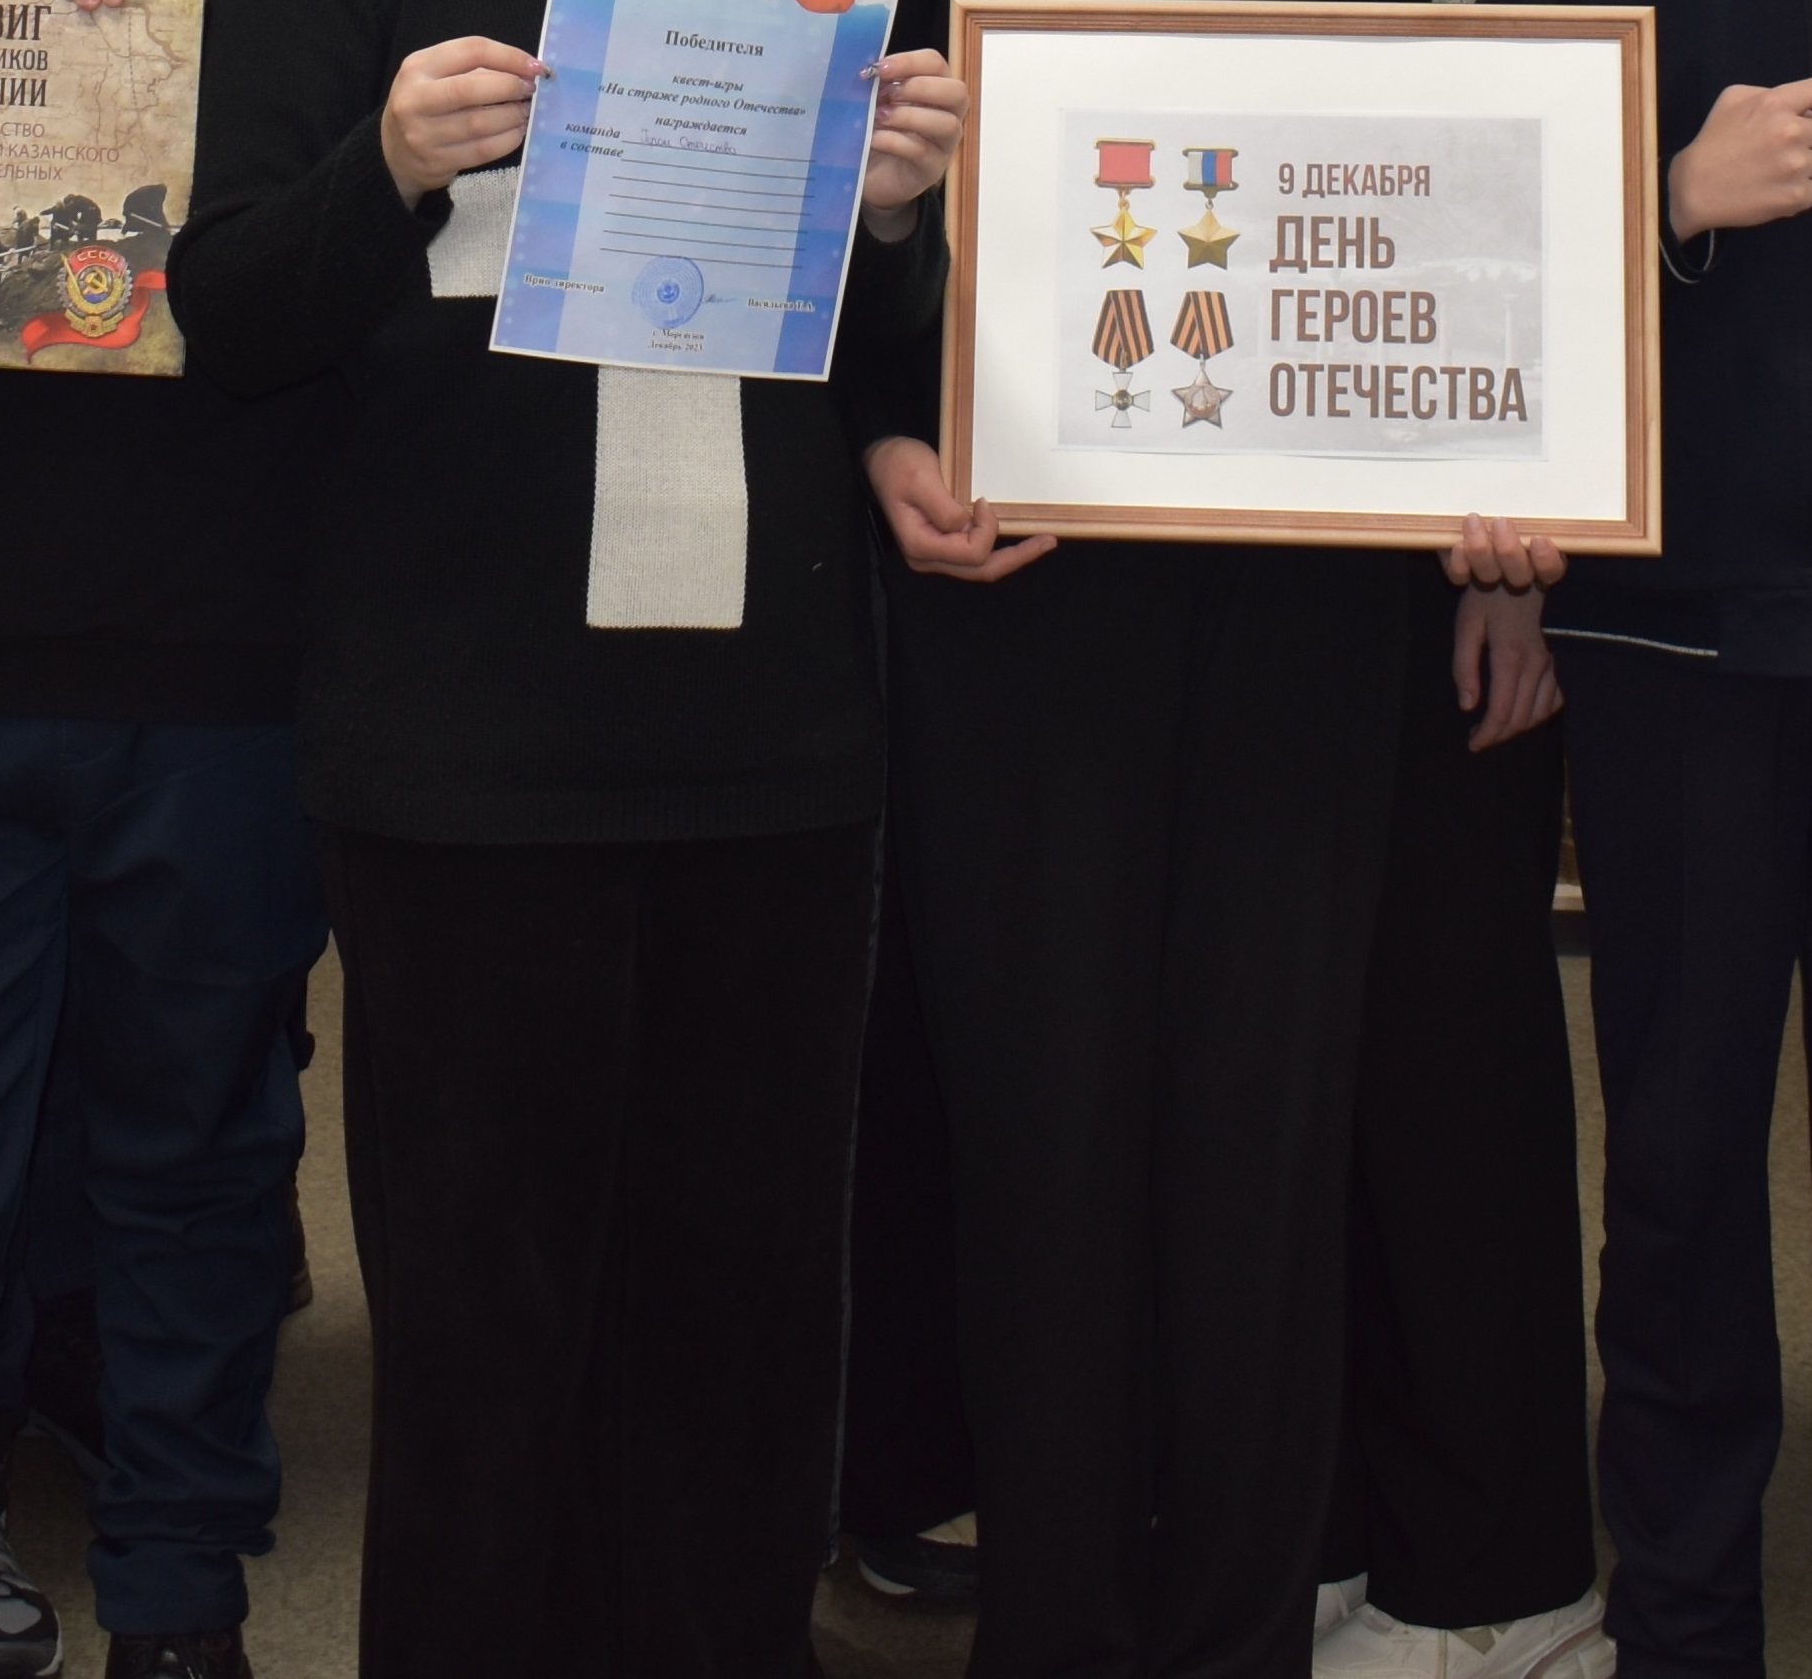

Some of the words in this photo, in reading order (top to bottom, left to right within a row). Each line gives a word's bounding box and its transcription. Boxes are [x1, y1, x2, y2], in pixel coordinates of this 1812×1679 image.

[666, 29, 764, 57] Победителя
[672, 73, 743, 92] квест-игры
[599, 83, 624, 96] «На
[628, 87, 679, 104] страже
[681, 95, 730, 110] родного
[733, 98, 805, 116] Отечества»
[565, 122, 621, 139] команда
[655, 115, 747, 136] награждается
[8, 143, 119, 162] КАЗАНСКОГО
[560, 141, 567, 150] в
[570, 142, 624, 158] составе
[1279, 163, 1295, 196] 9
[1302, 163, 1431, 200] ДЕКАБРЯ
[1269, 216, 1396, 273] ДЕНЬ
[1271, 289, 1438, 344] ГЕРОЕВ
[1270, 363, 1529, 422] ОТЕЧЕСТВА
